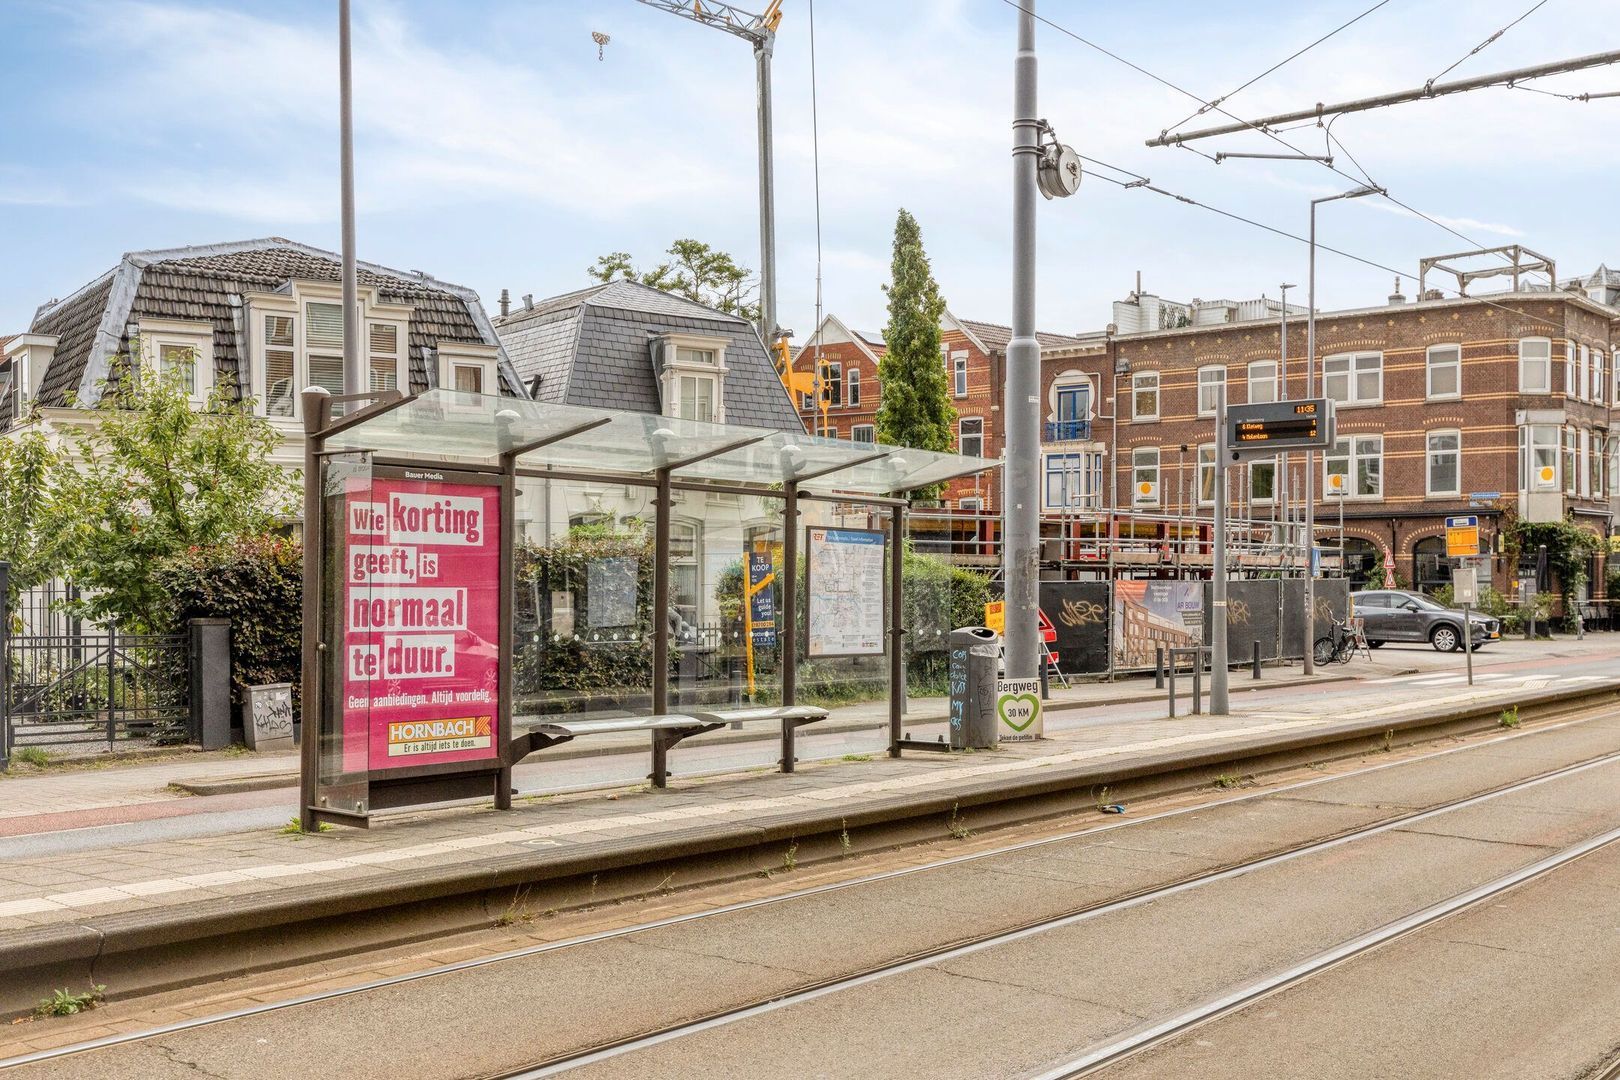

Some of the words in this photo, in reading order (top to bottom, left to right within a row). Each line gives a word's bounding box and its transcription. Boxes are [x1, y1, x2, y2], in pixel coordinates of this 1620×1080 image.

[1296, 405, 1315, 413] 11:35
[405, 471, 424, 479] Bauer
[424, 472, 443, 480] Media
[353, 508, 384, 531] Wie
[392, 497, 480, 543] korting
[353, 547, 415, 581] geeft,
[423, 554, 436, 575] is
[757, 556, 764, 564] TE
[751, 564, 769, 572] KOOP
[353, 589, 464, 628] normaal
[758, 603, 771, 612] guide
[1177, 601, 1185, 609] AR
[1185, 601, 1200, 609] BOUW
[352, 648, 377, 676] te
[387, 637, 453, 675] duur.
[998, 681, 1038, 694] Bergweg
[348, 695, 369, 709] Geen
[373, 692, 429, 708] aanbiedingen.
[431, 690, 453, 706] Altijd
[455, 688, 492, 704] voordelig.
[1008, 709, 1016, 717] 30
[1018, 708, 1029, 717] KM
[391, 720, 474, 741] HORNBACH
[404, 743, 411, 753] Er
[413, 743, 419, 752] is
[420, 741, 437, 753] altijd
[438, 740, 451, 750] iets
[452, 739, 459, 749] te
[460, 738, 476, 749] doen.
